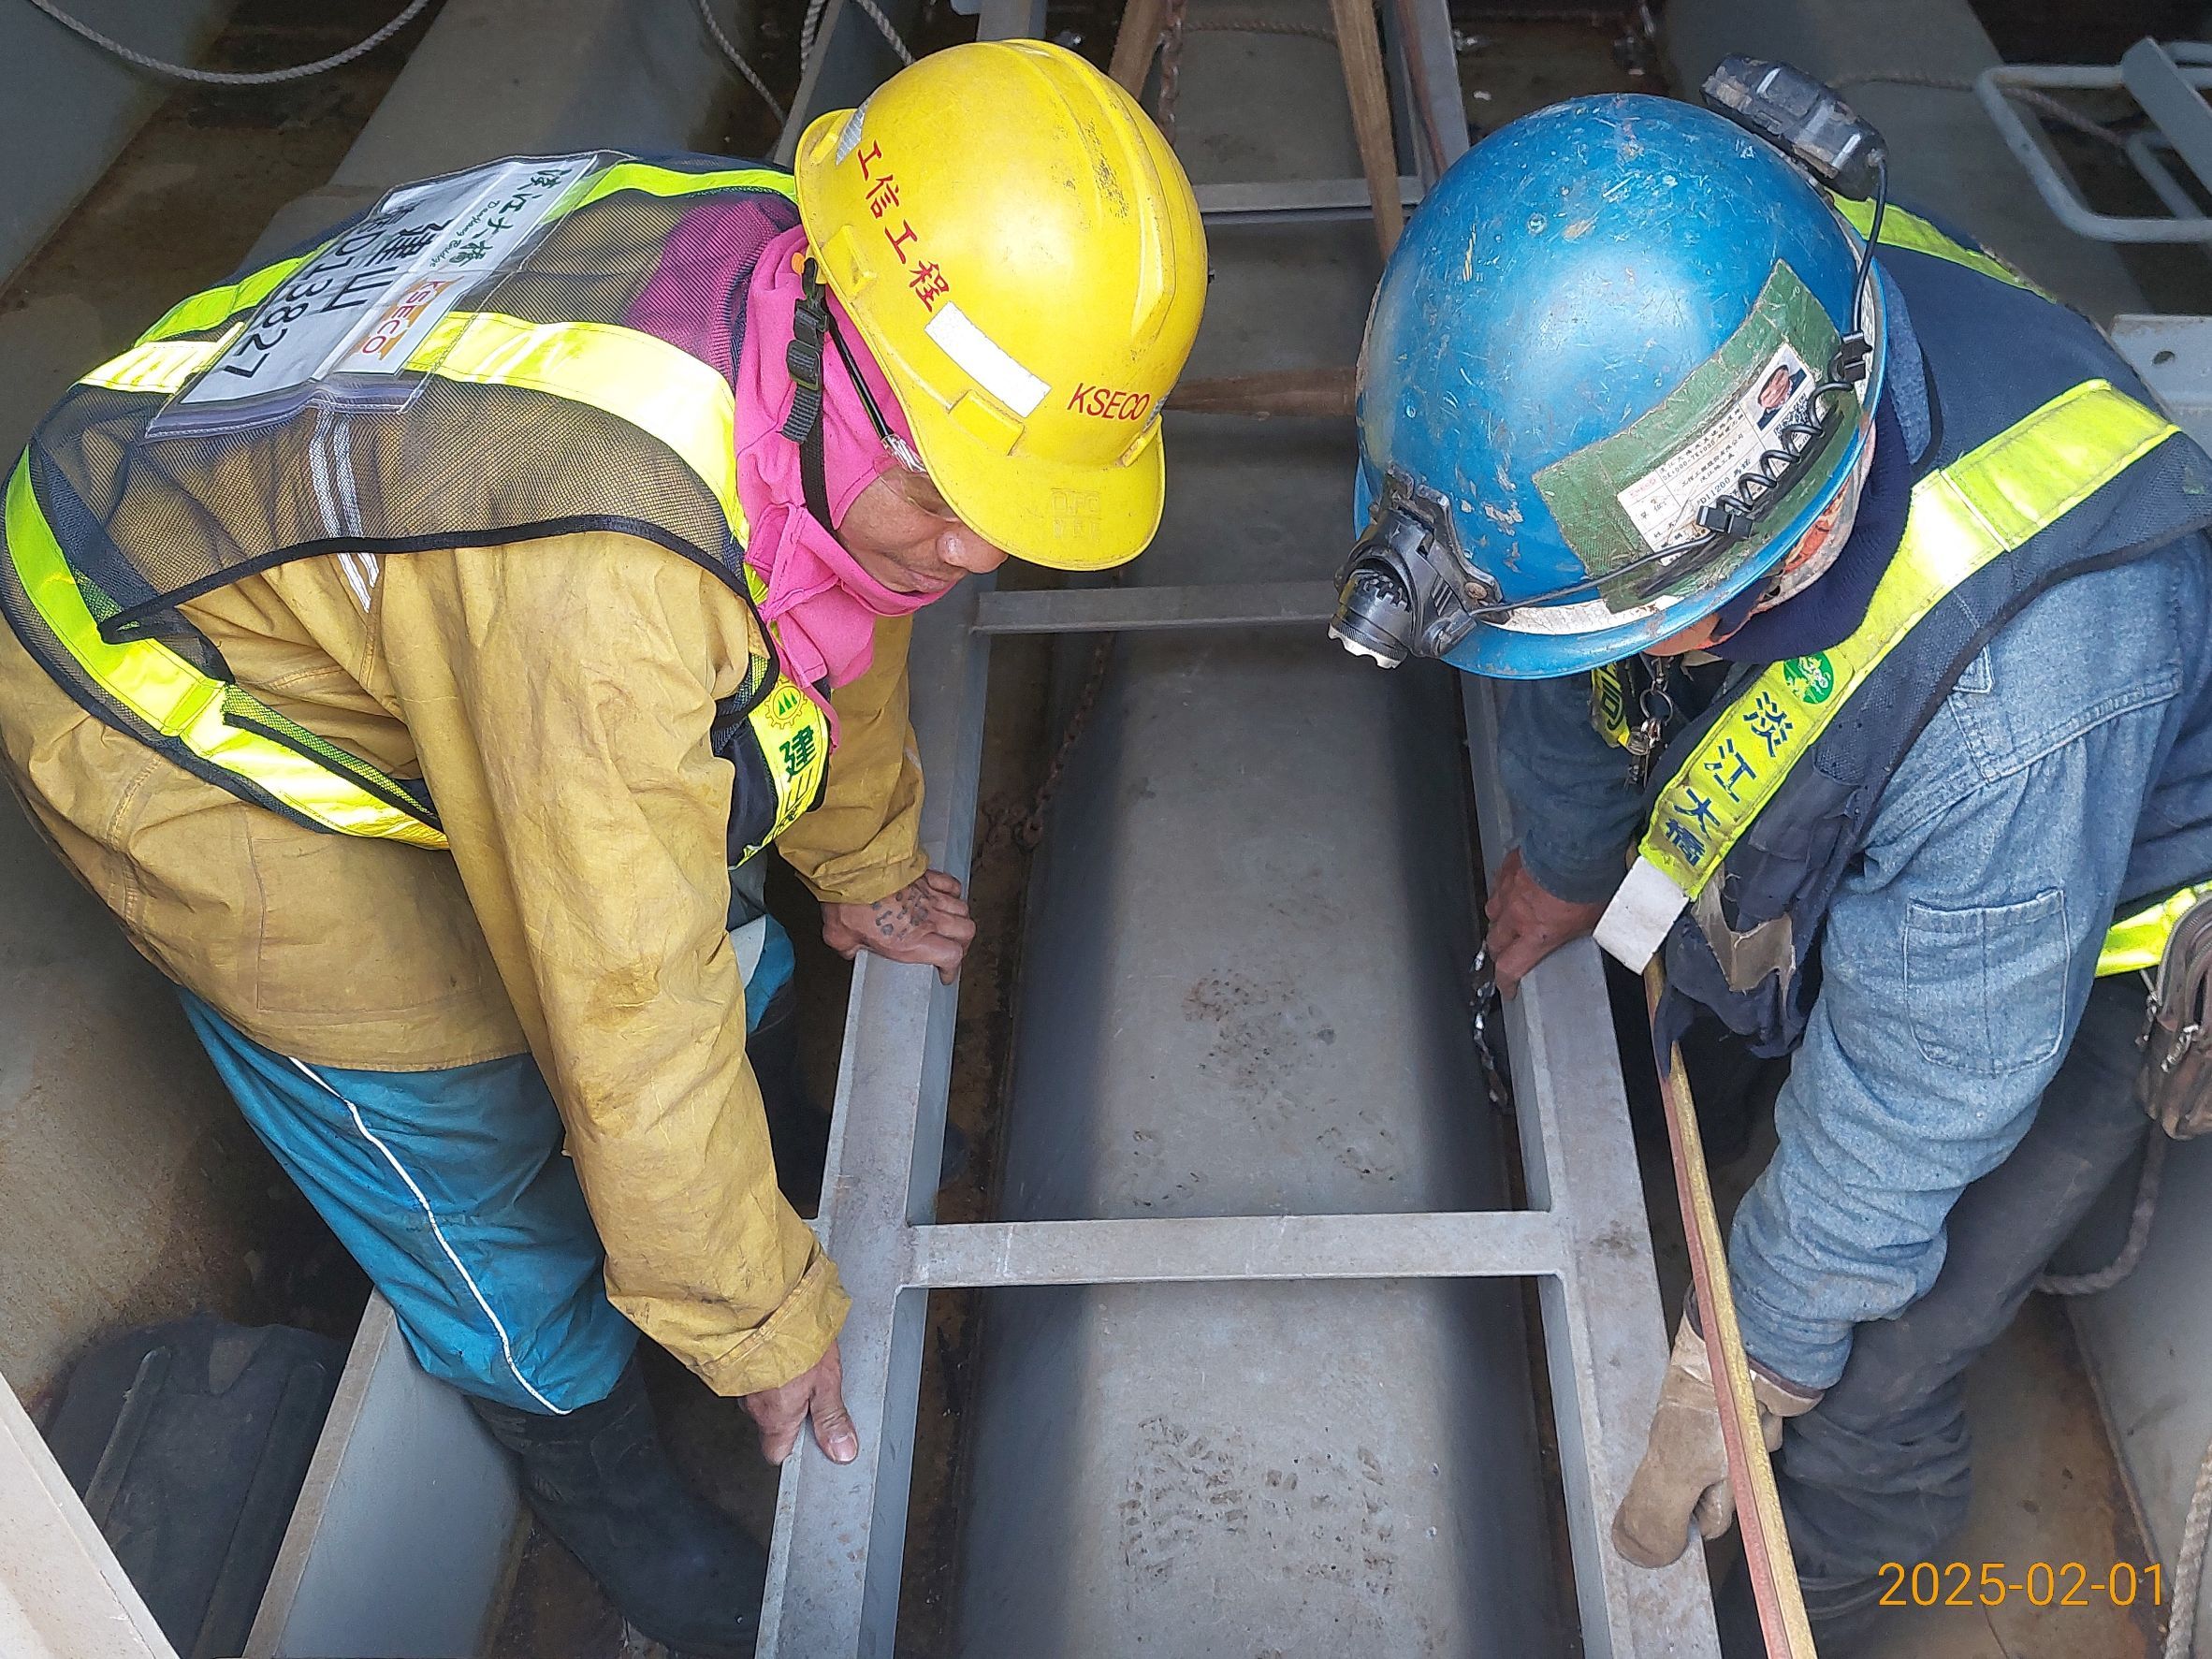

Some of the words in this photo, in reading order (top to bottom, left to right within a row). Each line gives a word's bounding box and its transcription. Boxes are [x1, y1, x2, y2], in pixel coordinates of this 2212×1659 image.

[321, 218, 455, 313] 建山
[449, 169, 573, 267] 淡江大橋
[857, 139, 949, 312] 工信工程
[362, 280, 445, 354] KSECO
[1068, 382, 1150, 421] KSECO
[1662, 691, 1795, 866] 淡江大橋
